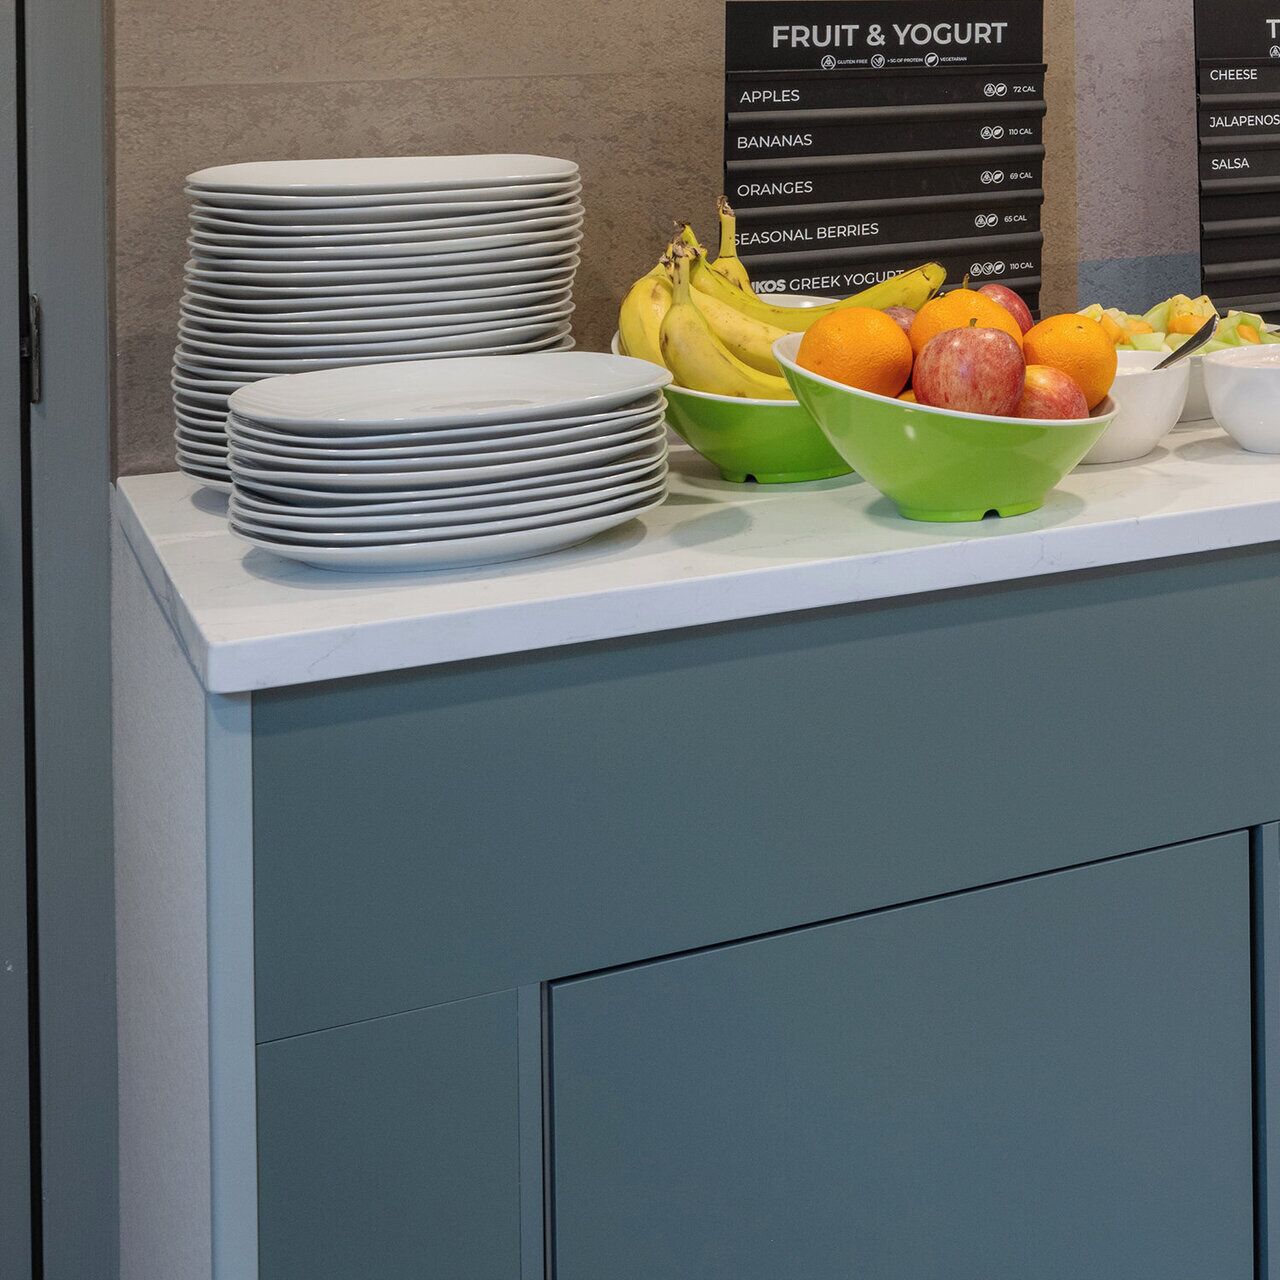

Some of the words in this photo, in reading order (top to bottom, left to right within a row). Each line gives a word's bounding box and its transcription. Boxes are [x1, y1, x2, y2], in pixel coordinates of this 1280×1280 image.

[773, 25, 859, 47] FRUIT
[867, 24, 885, 46] &
[893, 23, 1007, 45] YOGURT
[1210, 69, 1257, 80] CHEESE
[740, 90, 799, 103] APPLES
[1210, 115, 1280, 127] JALAPENOS
[738, 134, 812, 148] BANANAS
[1212, 158, 1249, 170] SALSA
[737, 181, 812, 196] ORANGES
[733, 228, 813, 246] SEASONAL
[817, 223, 878, 239] BERRIES
[751, 279, 786, 294] IKOS
[790, 275, 840, 290] GREEK
